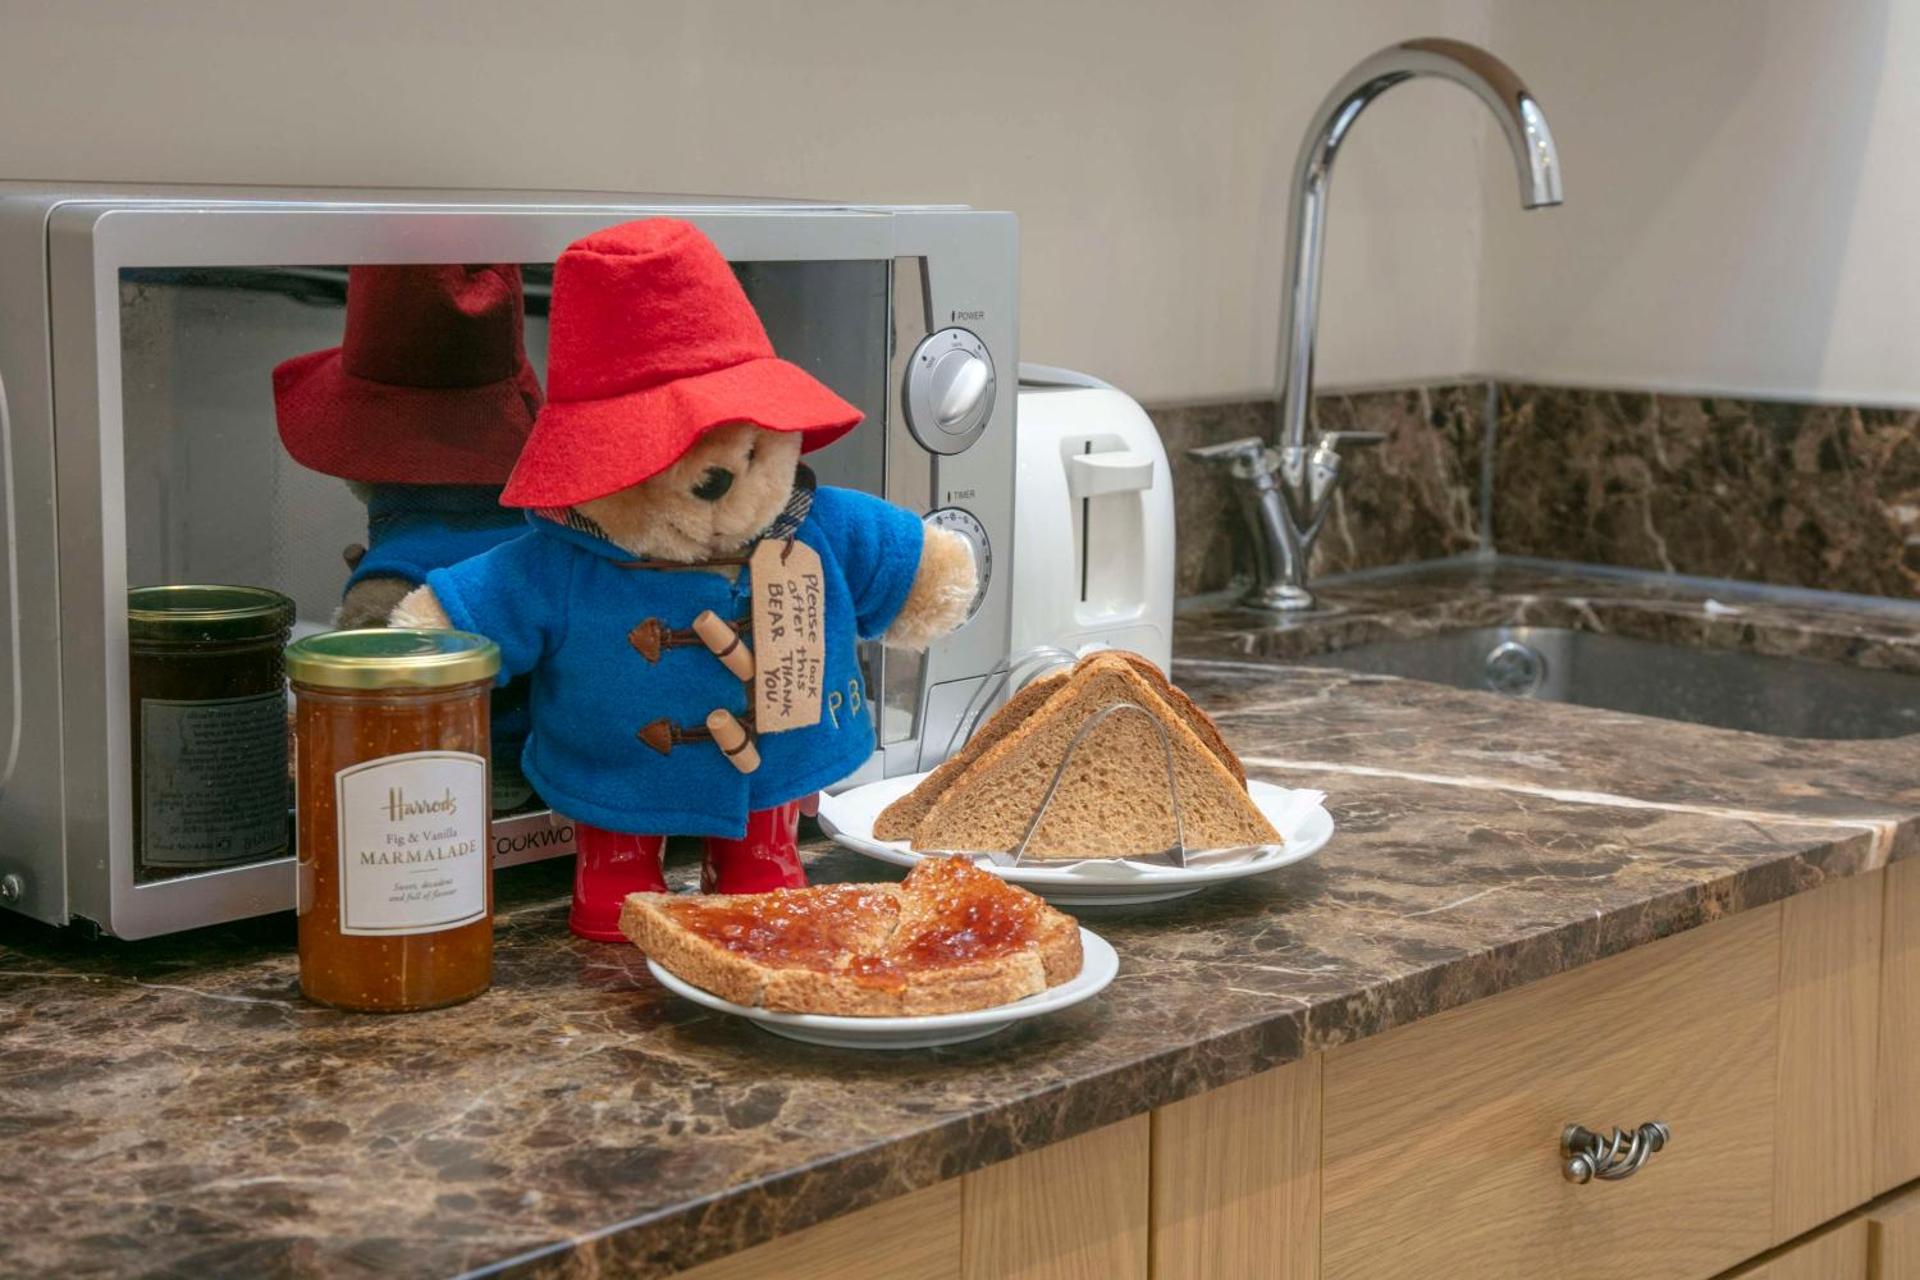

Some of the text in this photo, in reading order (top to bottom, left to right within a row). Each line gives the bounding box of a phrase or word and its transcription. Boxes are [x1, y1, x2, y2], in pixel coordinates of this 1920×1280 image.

[958, 311, 985, 321] POWER
[954, 489, 976, 500] TIMER
[768, 583, 793, 717] BEAR THANK
[788, 580, 807, 691] after this
[802, 574, 820, 698] Please look
[381, 787, 457, 821] Harrods
[360, 840, 477, 865] MARMALADE
[386, 827, 457, 847] Fig & Vanilla
[491, 826, 574, 859] OOKWO
